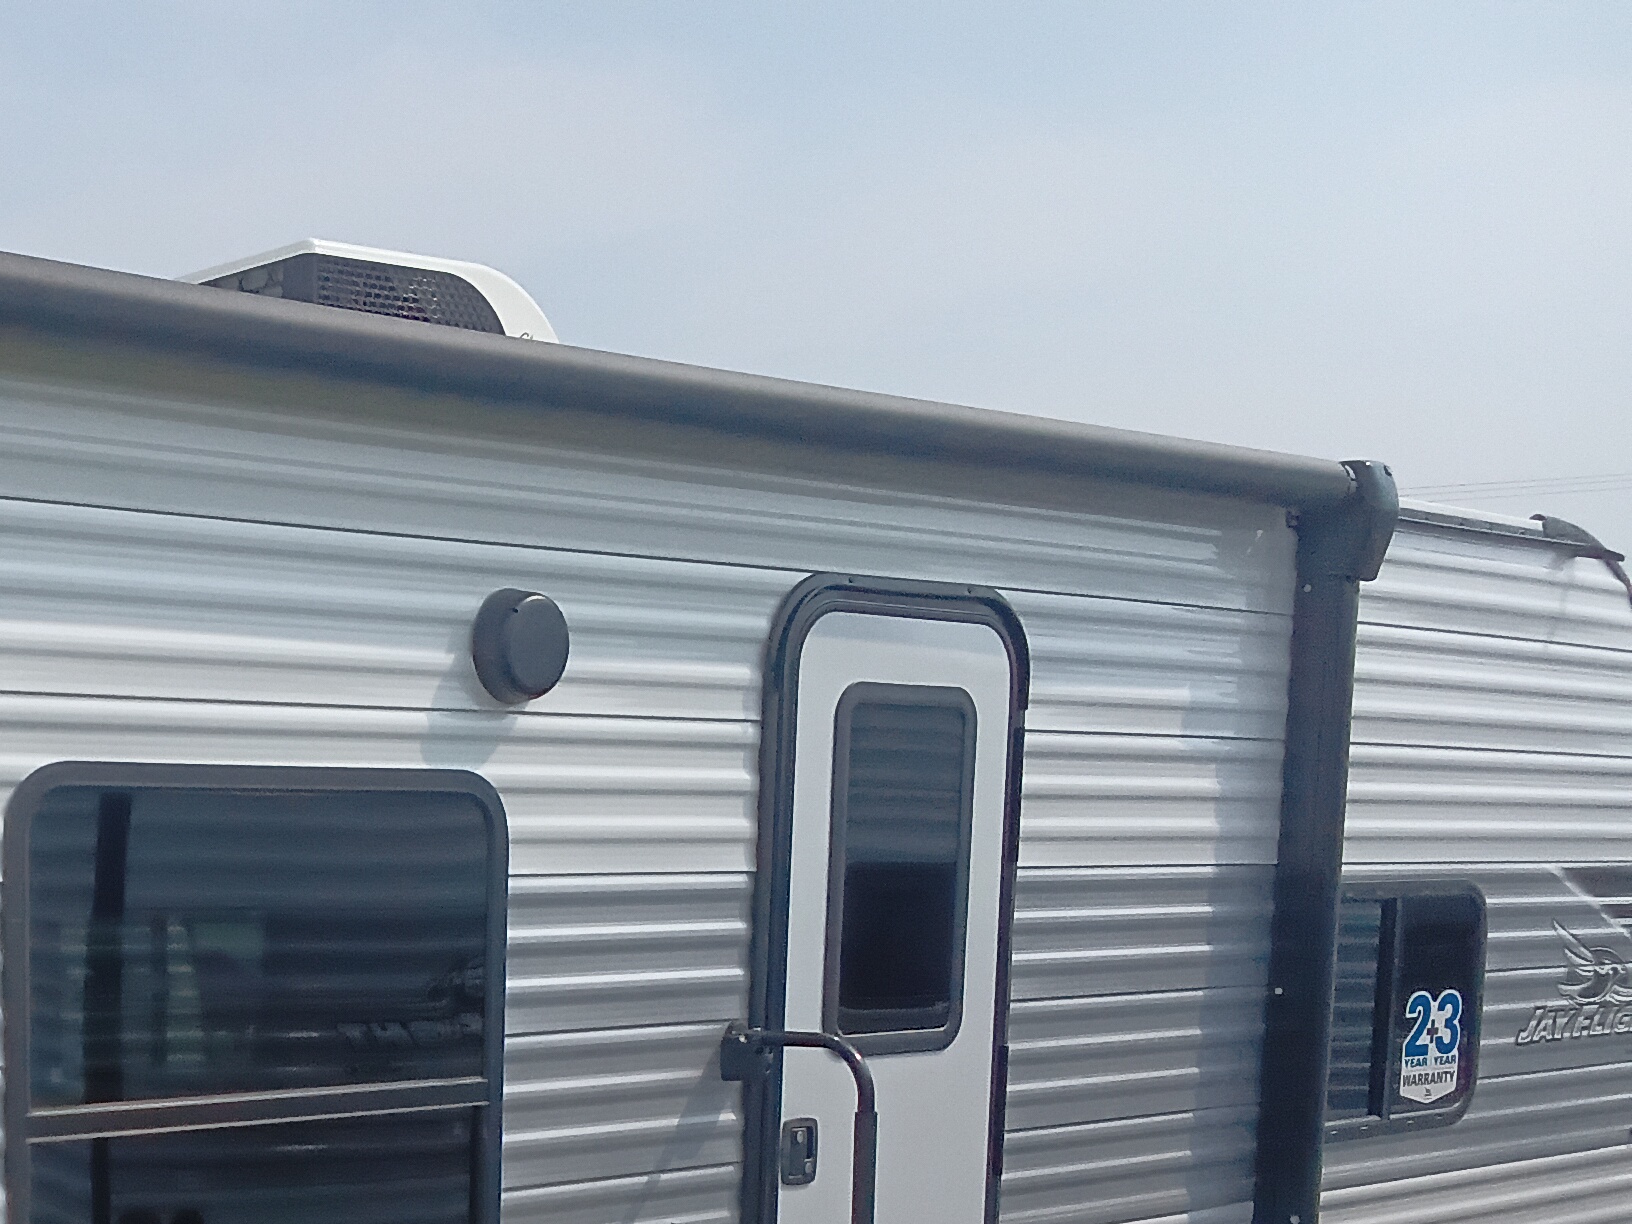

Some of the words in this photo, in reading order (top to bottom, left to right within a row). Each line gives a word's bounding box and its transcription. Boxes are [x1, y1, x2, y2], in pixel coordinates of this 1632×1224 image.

[1404, 1057, 1428, 1068] YEAR
[1433, 1055, 1457, 1066] YEAR
[1402, 1070, 1456, 1087] WARRANTY
